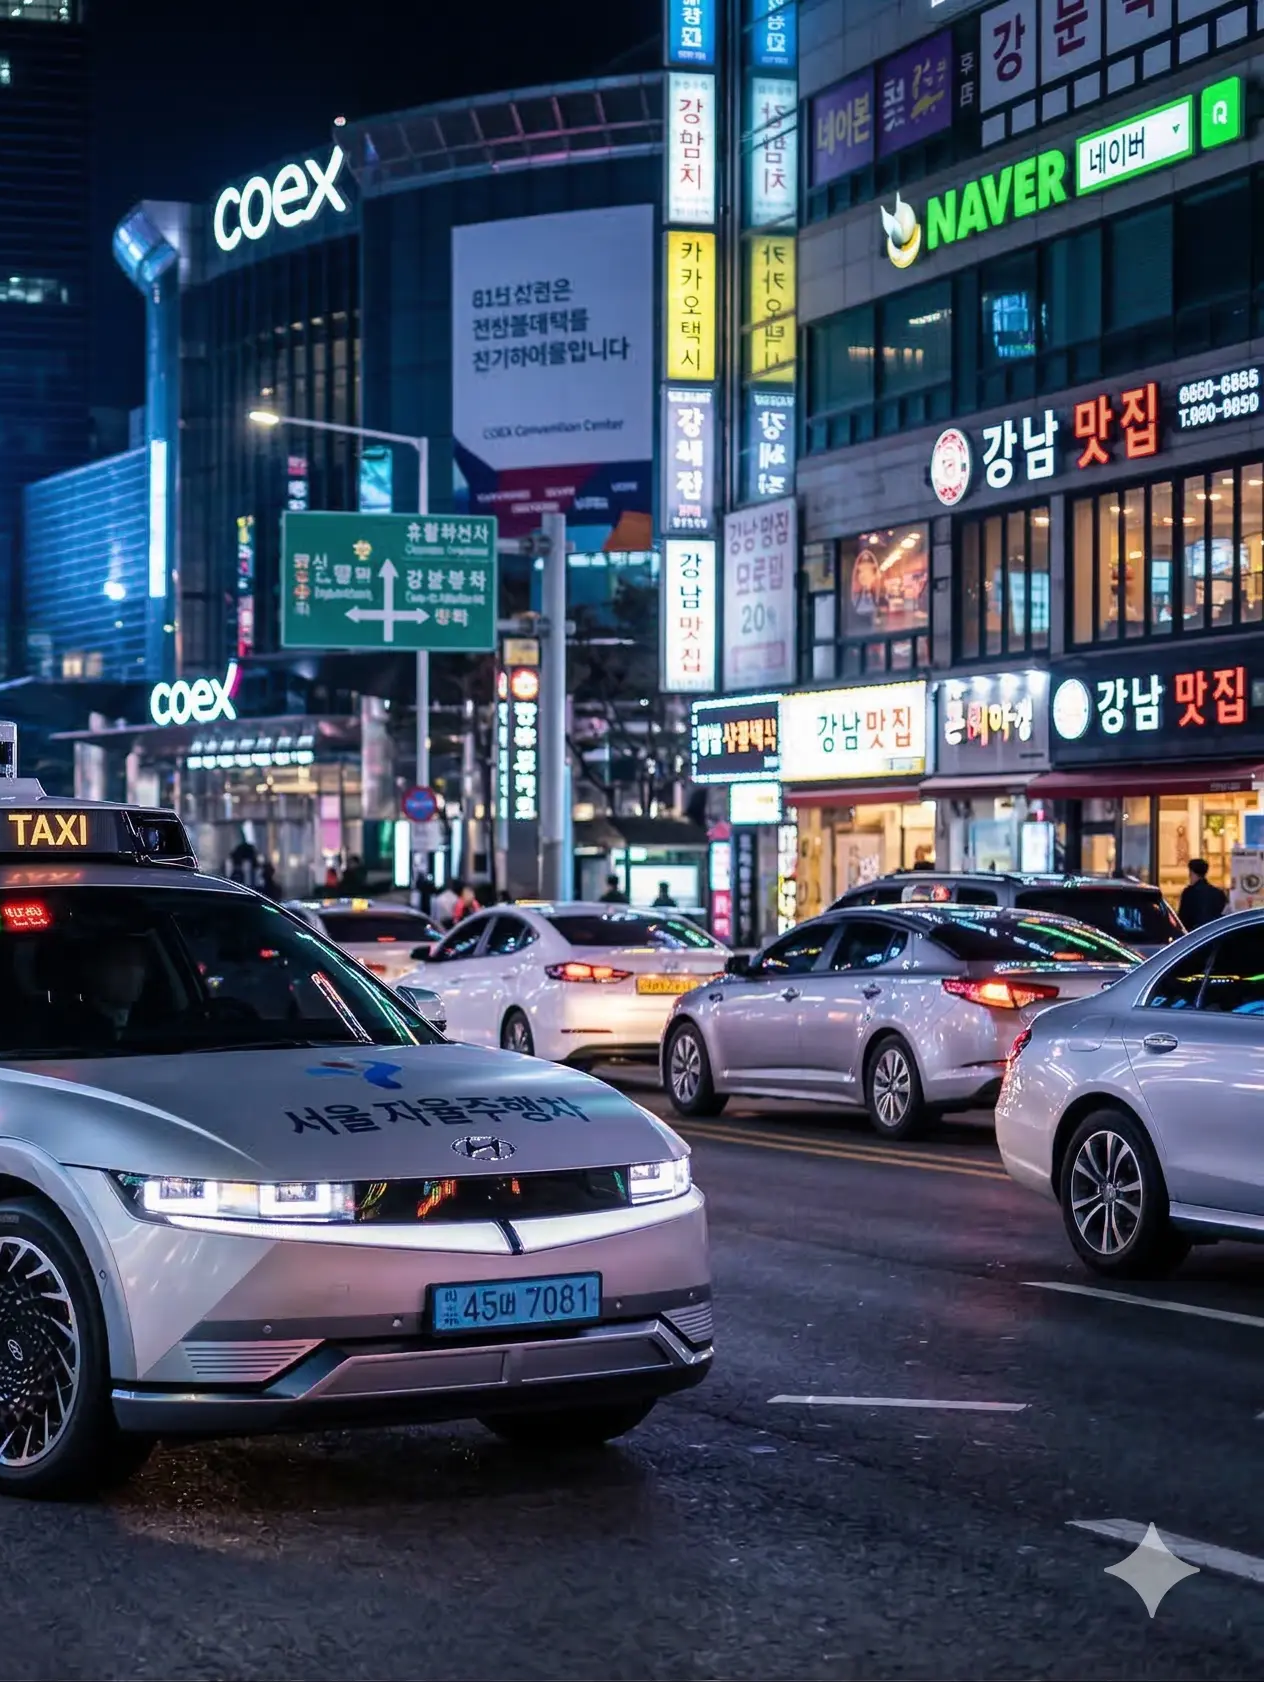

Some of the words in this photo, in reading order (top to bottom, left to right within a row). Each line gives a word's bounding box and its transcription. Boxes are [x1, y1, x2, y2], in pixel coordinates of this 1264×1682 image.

[1088, 126, 1145, 174] 네이버
[926, 149, 1067, 250] NAVER
[681, 241, 703, 371] 카카오택시
[982, 408, 1059, 489] 강남
[1073, 381, 1159, 469] 맛집
[680, 553, 703, 673] 강남맛집
[1097, 674, 1165, 735] 강남
[1174, 666, 1248, 727] 맛집
[8, 814, 88, 846] TAXI
[284, 1104, 383, 1136] 서울
[371, 1095, 591, 1127] 자율주행차
[525, 1284, 588, 1319] 7081
